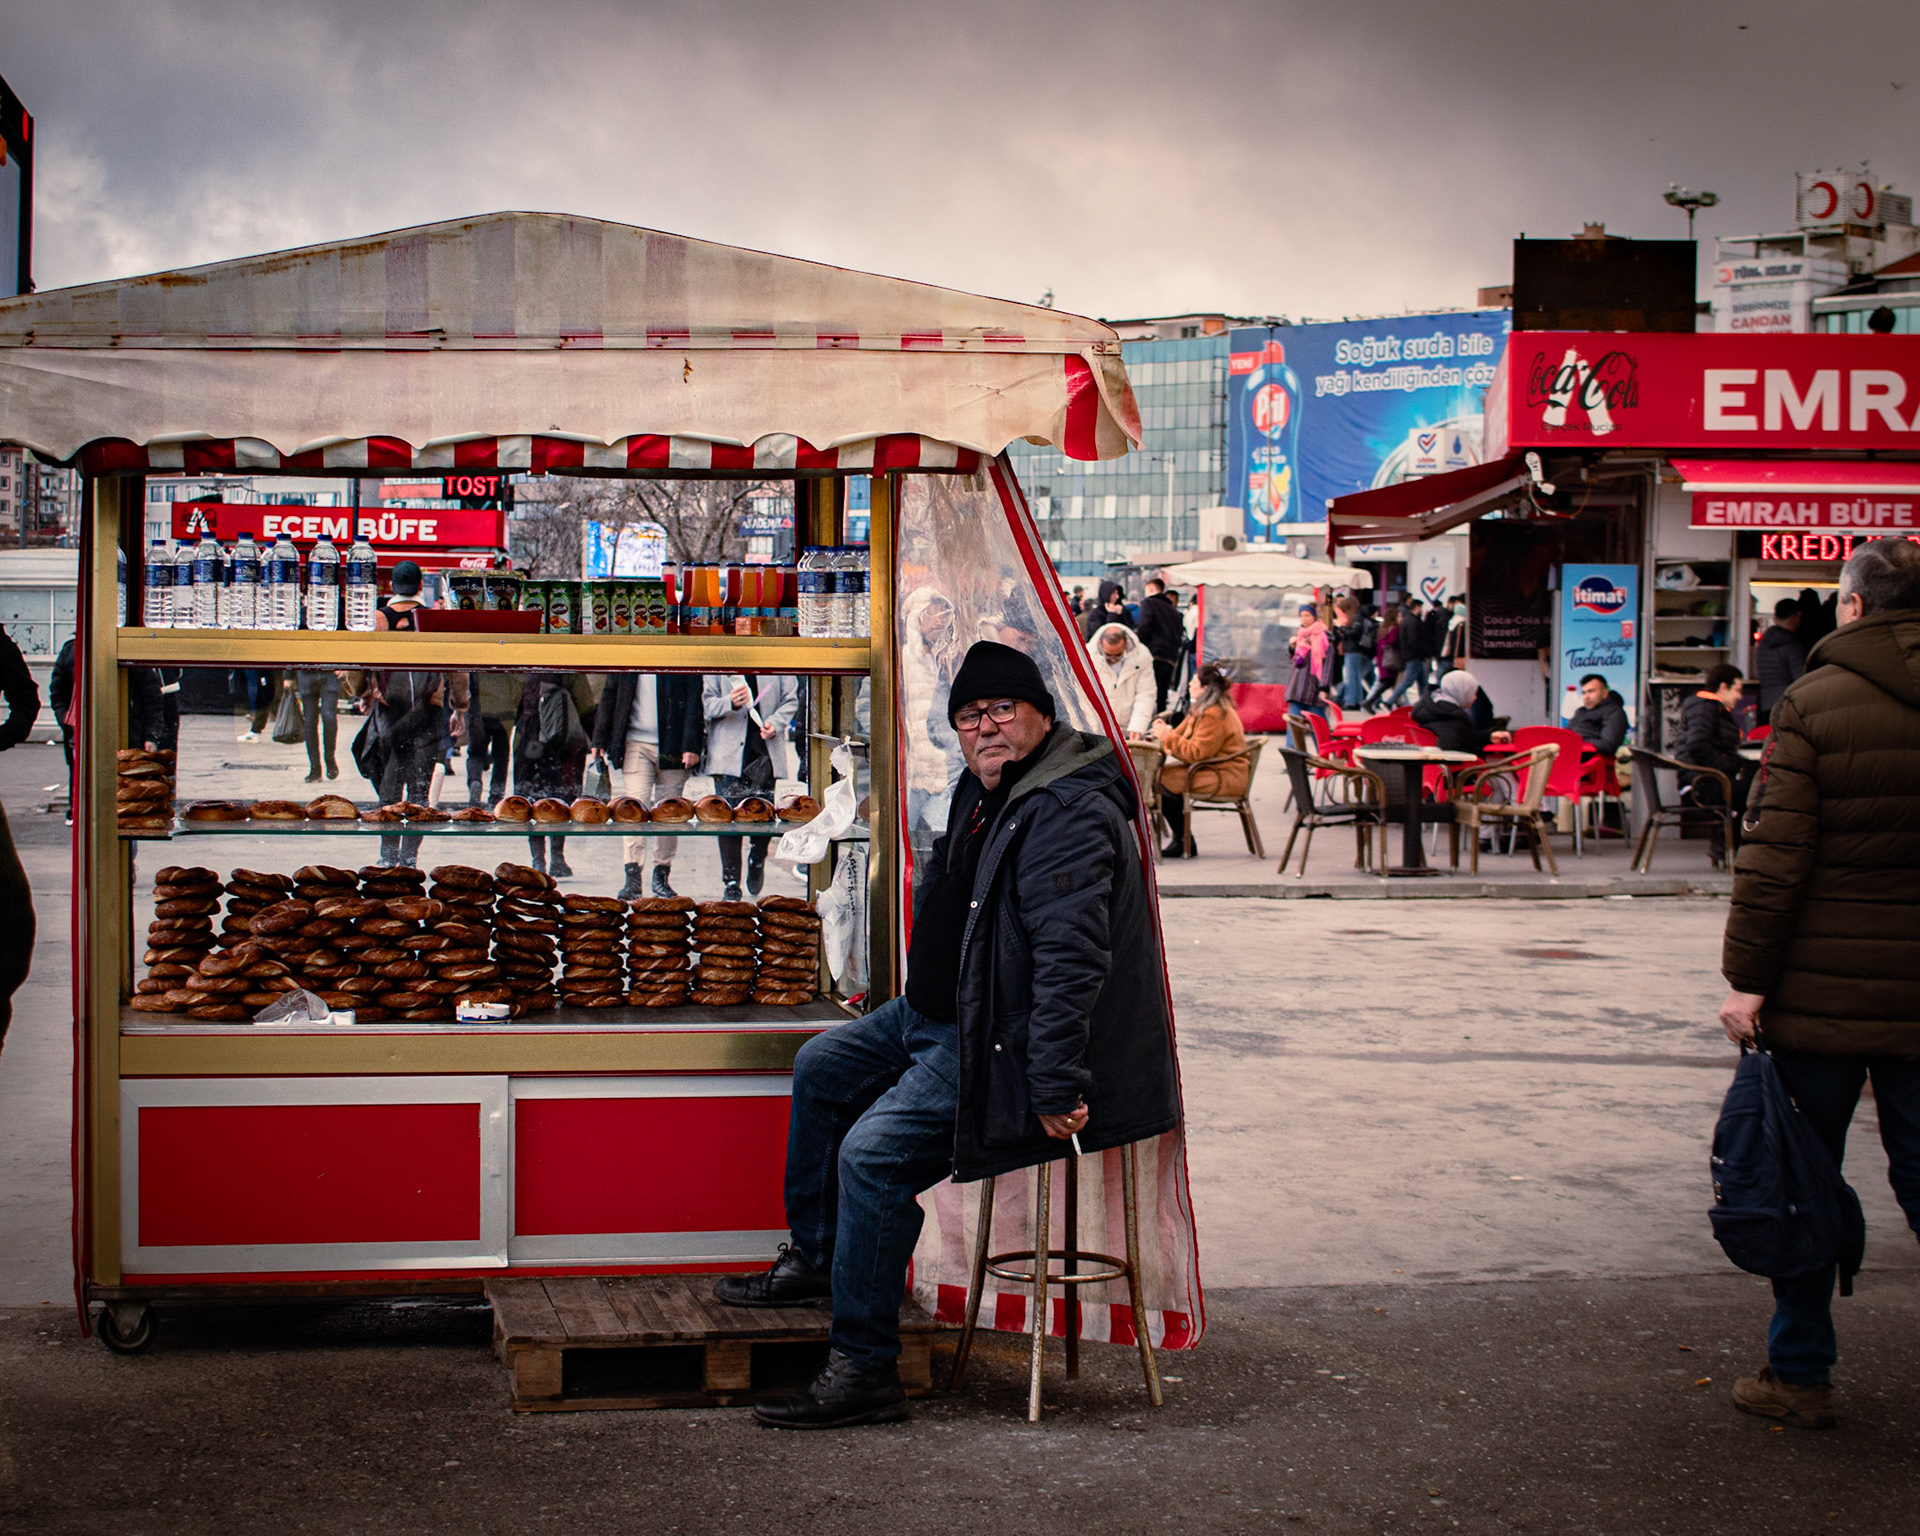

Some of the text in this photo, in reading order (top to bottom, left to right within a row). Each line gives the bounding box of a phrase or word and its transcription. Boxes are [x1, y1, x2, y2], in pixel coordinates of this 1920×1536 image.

[1731, 315, 1791, 329] CANDAN
[1336, 332, 1493, 366] Soğuk suda bile
[1316, 370, 1351, 397] yağı
[1353, 365, 1461, 391] kendiliğinden
[1704, 369, 1920, 431] EMR
[444, 475, 499, 497] TOST
[1706, 498, 1913, 526] EMRAH BÜFE
[262, 512, 437, 542] ECEM BÜFE
[1575, 587, 1624, 603] itimat
